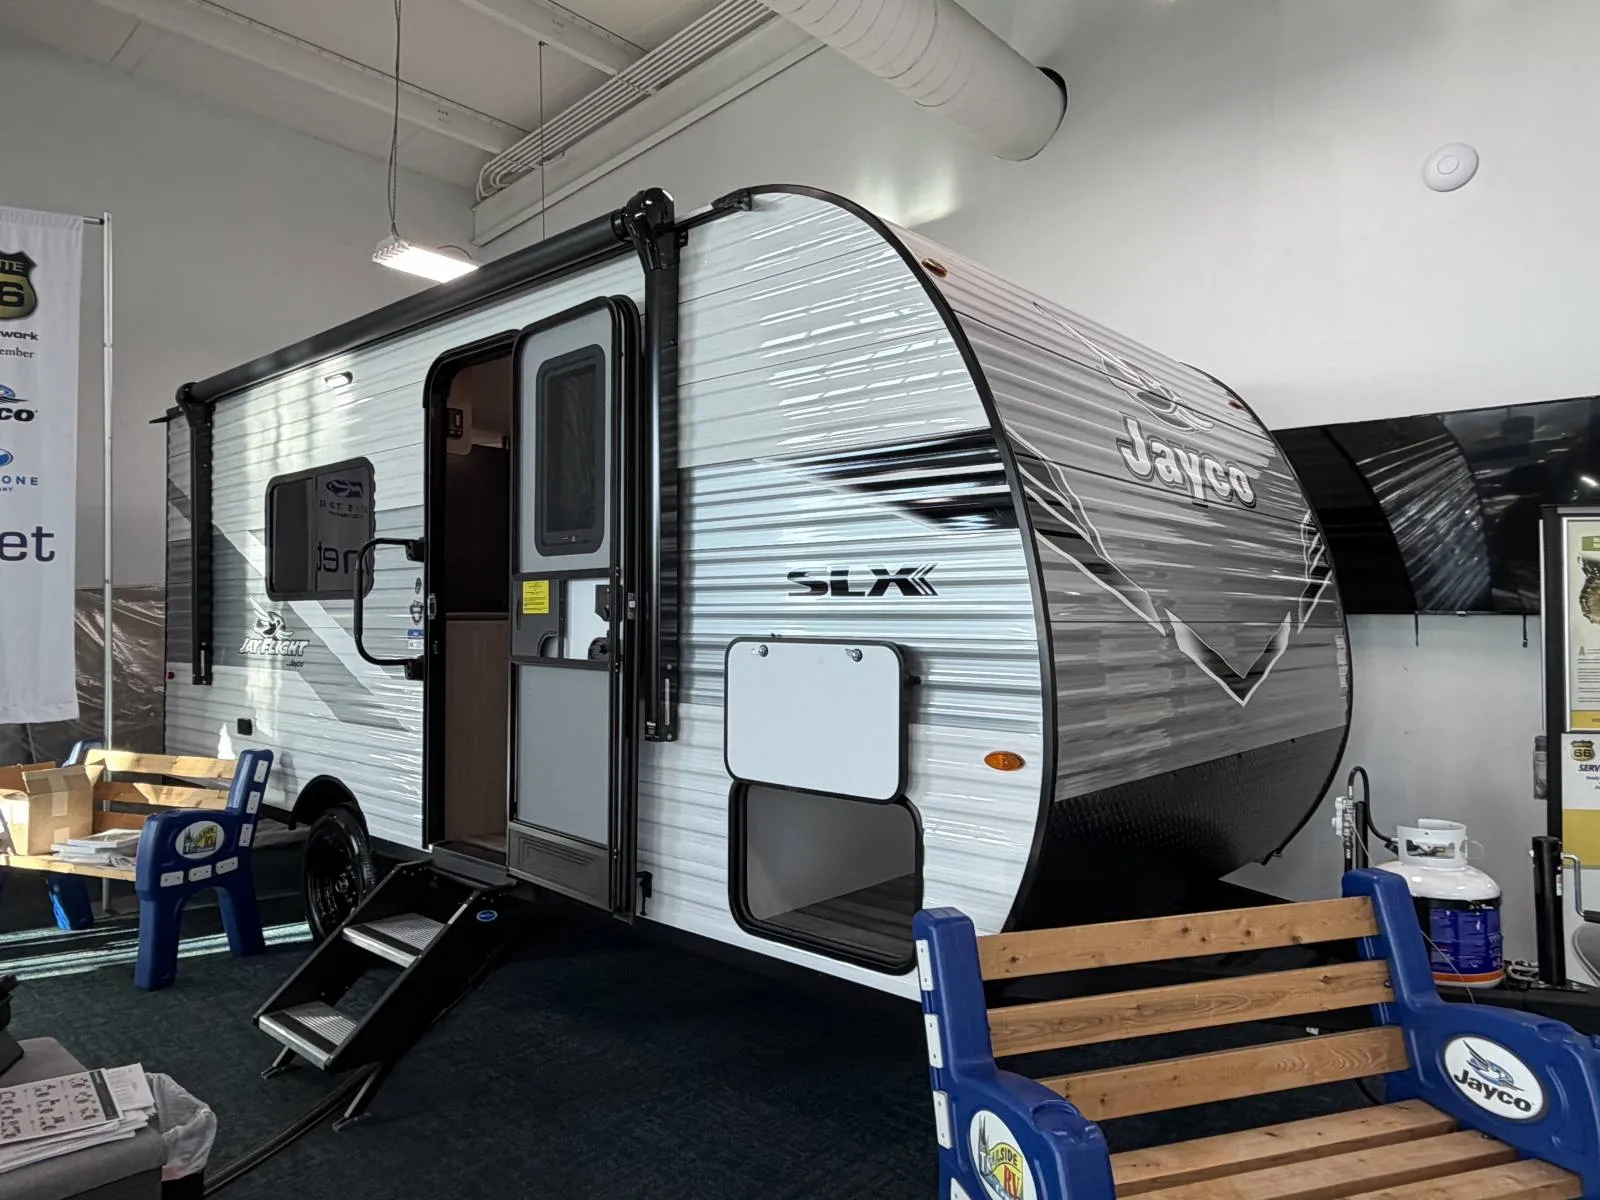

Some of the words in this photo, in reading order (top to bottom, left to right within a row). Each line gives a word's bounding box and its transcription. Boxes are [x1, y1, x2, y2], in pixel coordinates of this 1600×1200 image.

[1115, 410, 1256, 508] Jayco
[786, 565, 938, 597] SLX
[1453, 1069, 1532, 1112] Jayco
